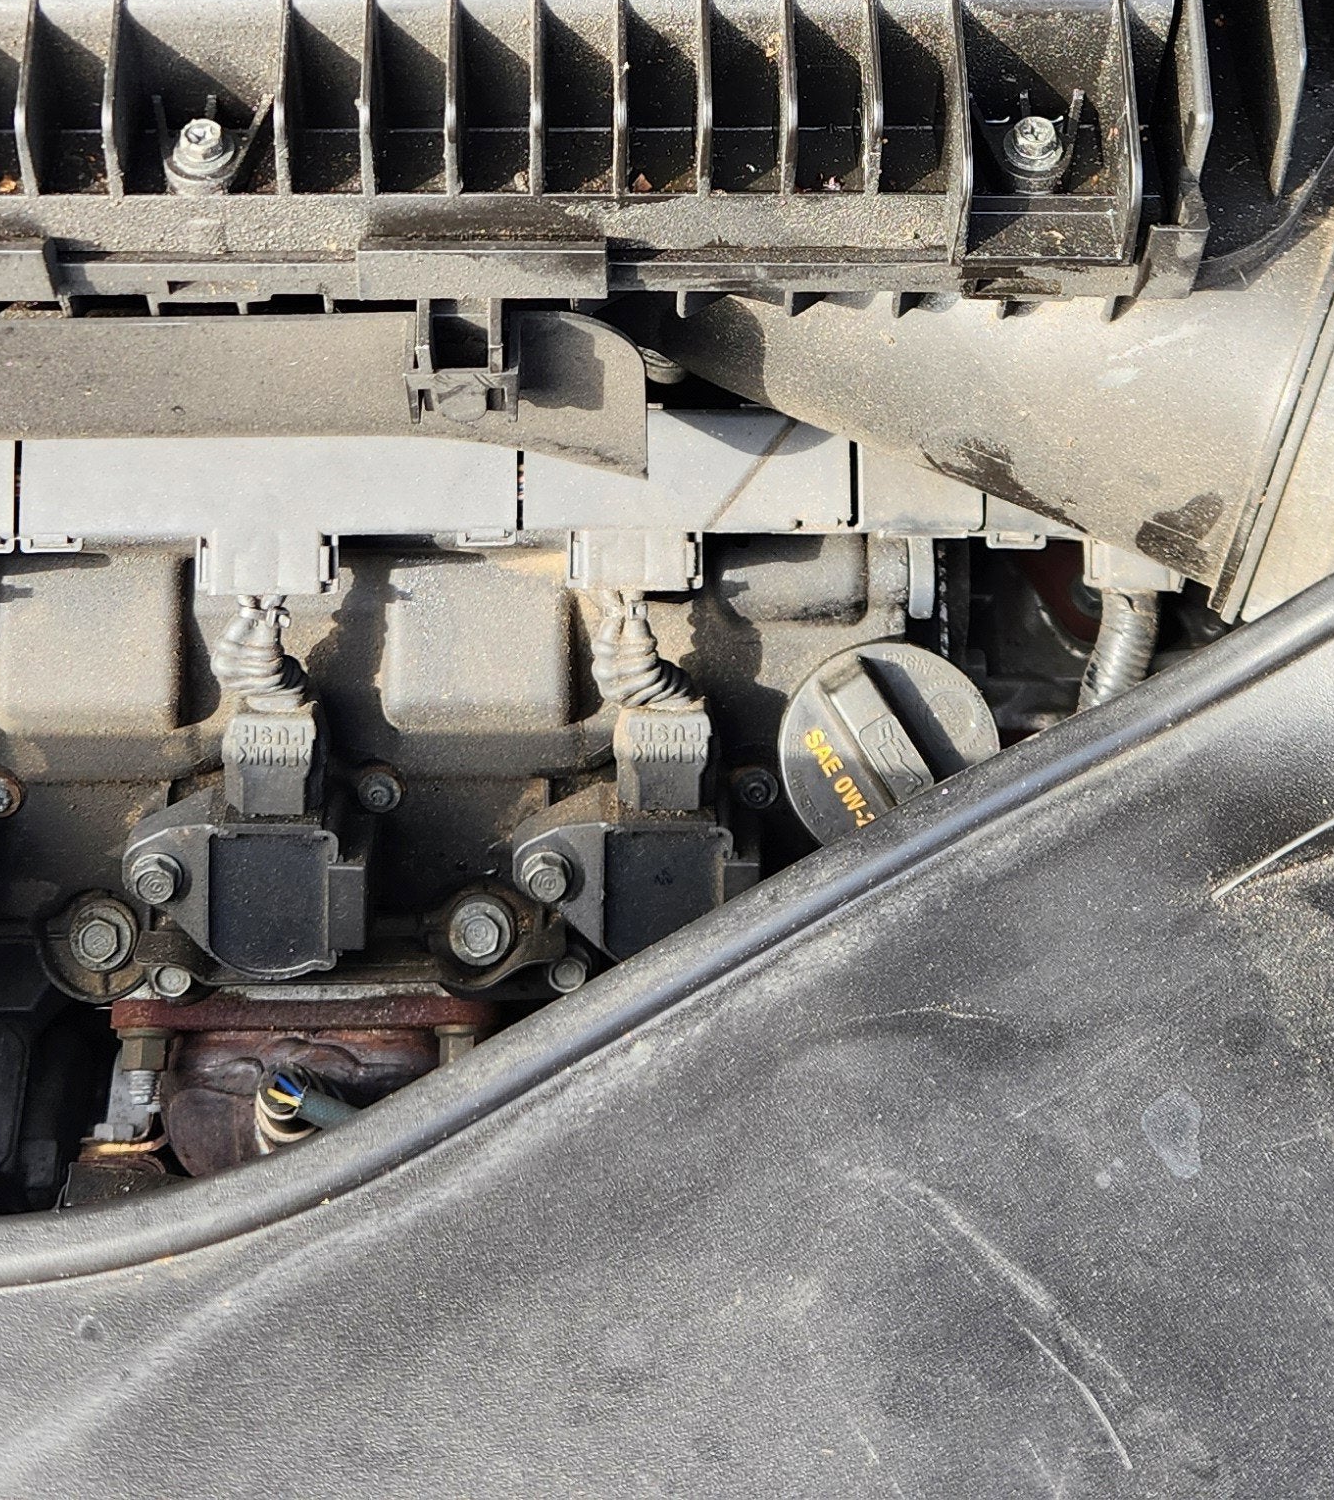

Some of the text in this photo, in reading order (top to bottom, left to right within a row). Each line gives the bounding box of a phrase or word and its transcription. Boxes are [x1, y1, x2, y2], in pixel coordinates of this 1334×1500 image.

[243, 723, 307, 746] PUSH
[640, 721, 702, 742] PUSH
[803, 727, 845, 779] SAE
